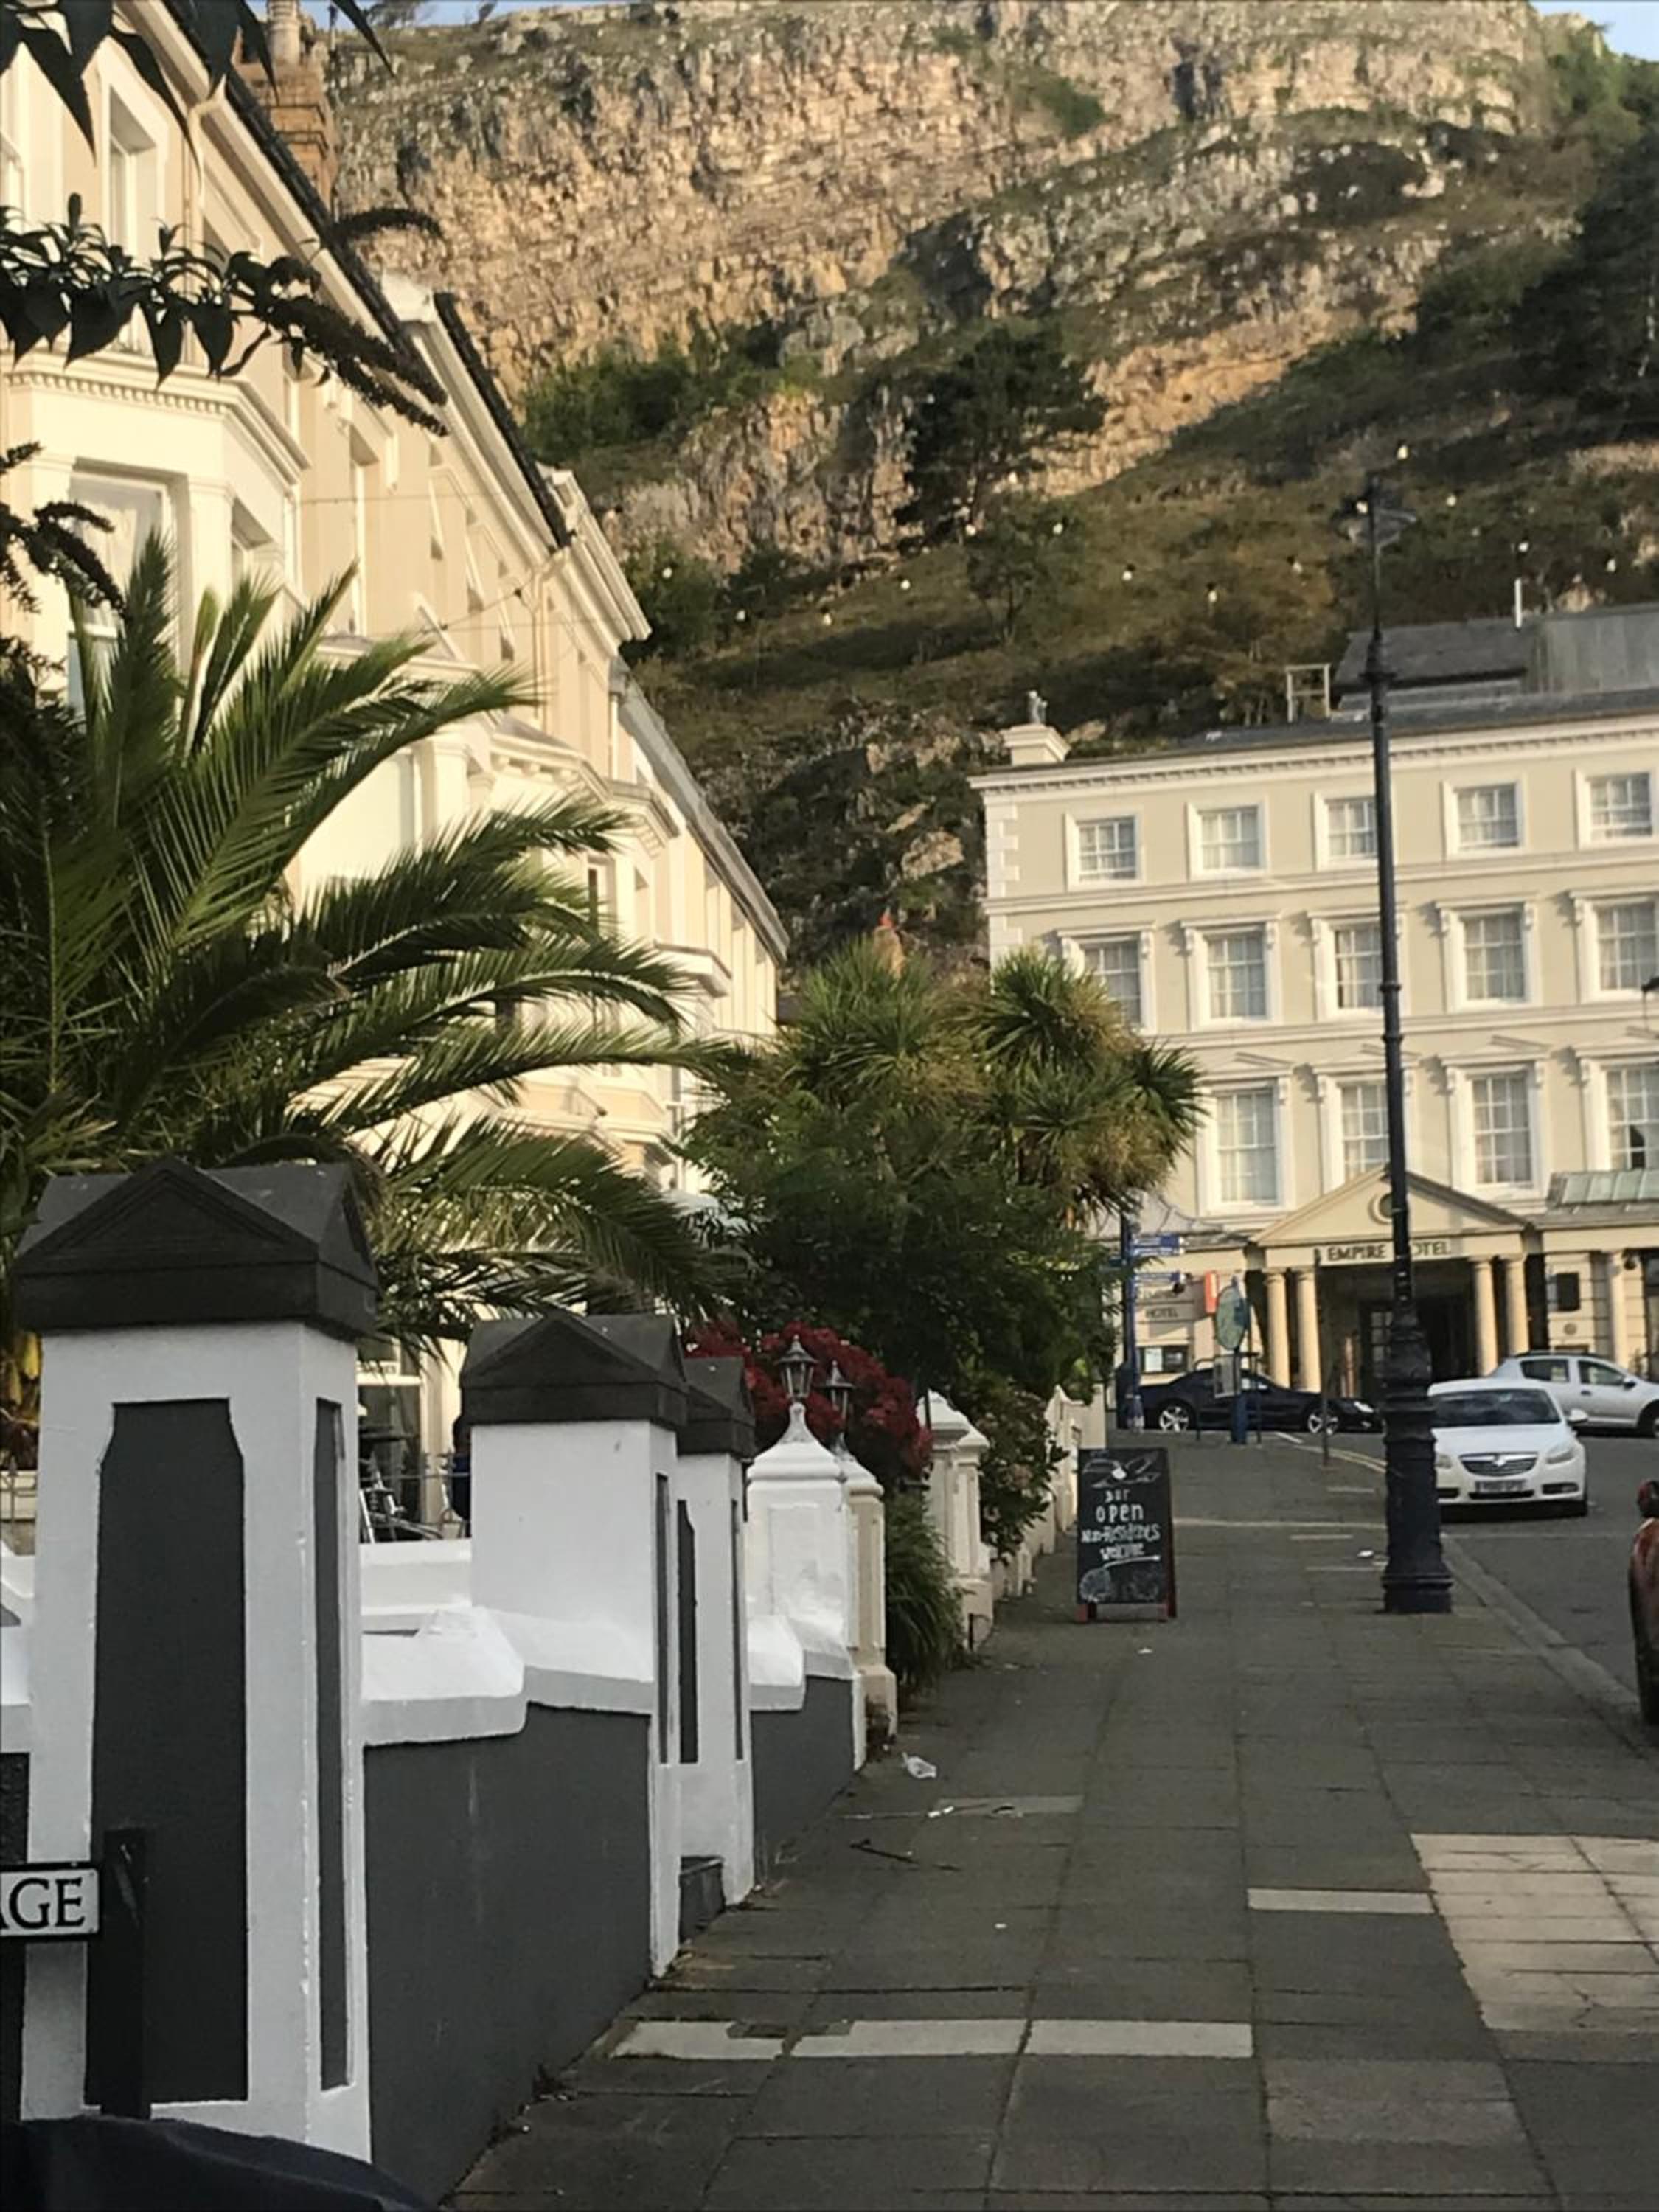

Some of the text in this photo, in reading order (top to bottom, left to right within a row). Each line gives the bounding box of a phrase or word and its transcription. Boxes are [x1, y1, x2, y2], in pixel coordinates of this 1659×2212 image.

[1327, 1240, 1447, 1262] EMPIRE OTEL
[0, 1877, 85, 1930] GE
